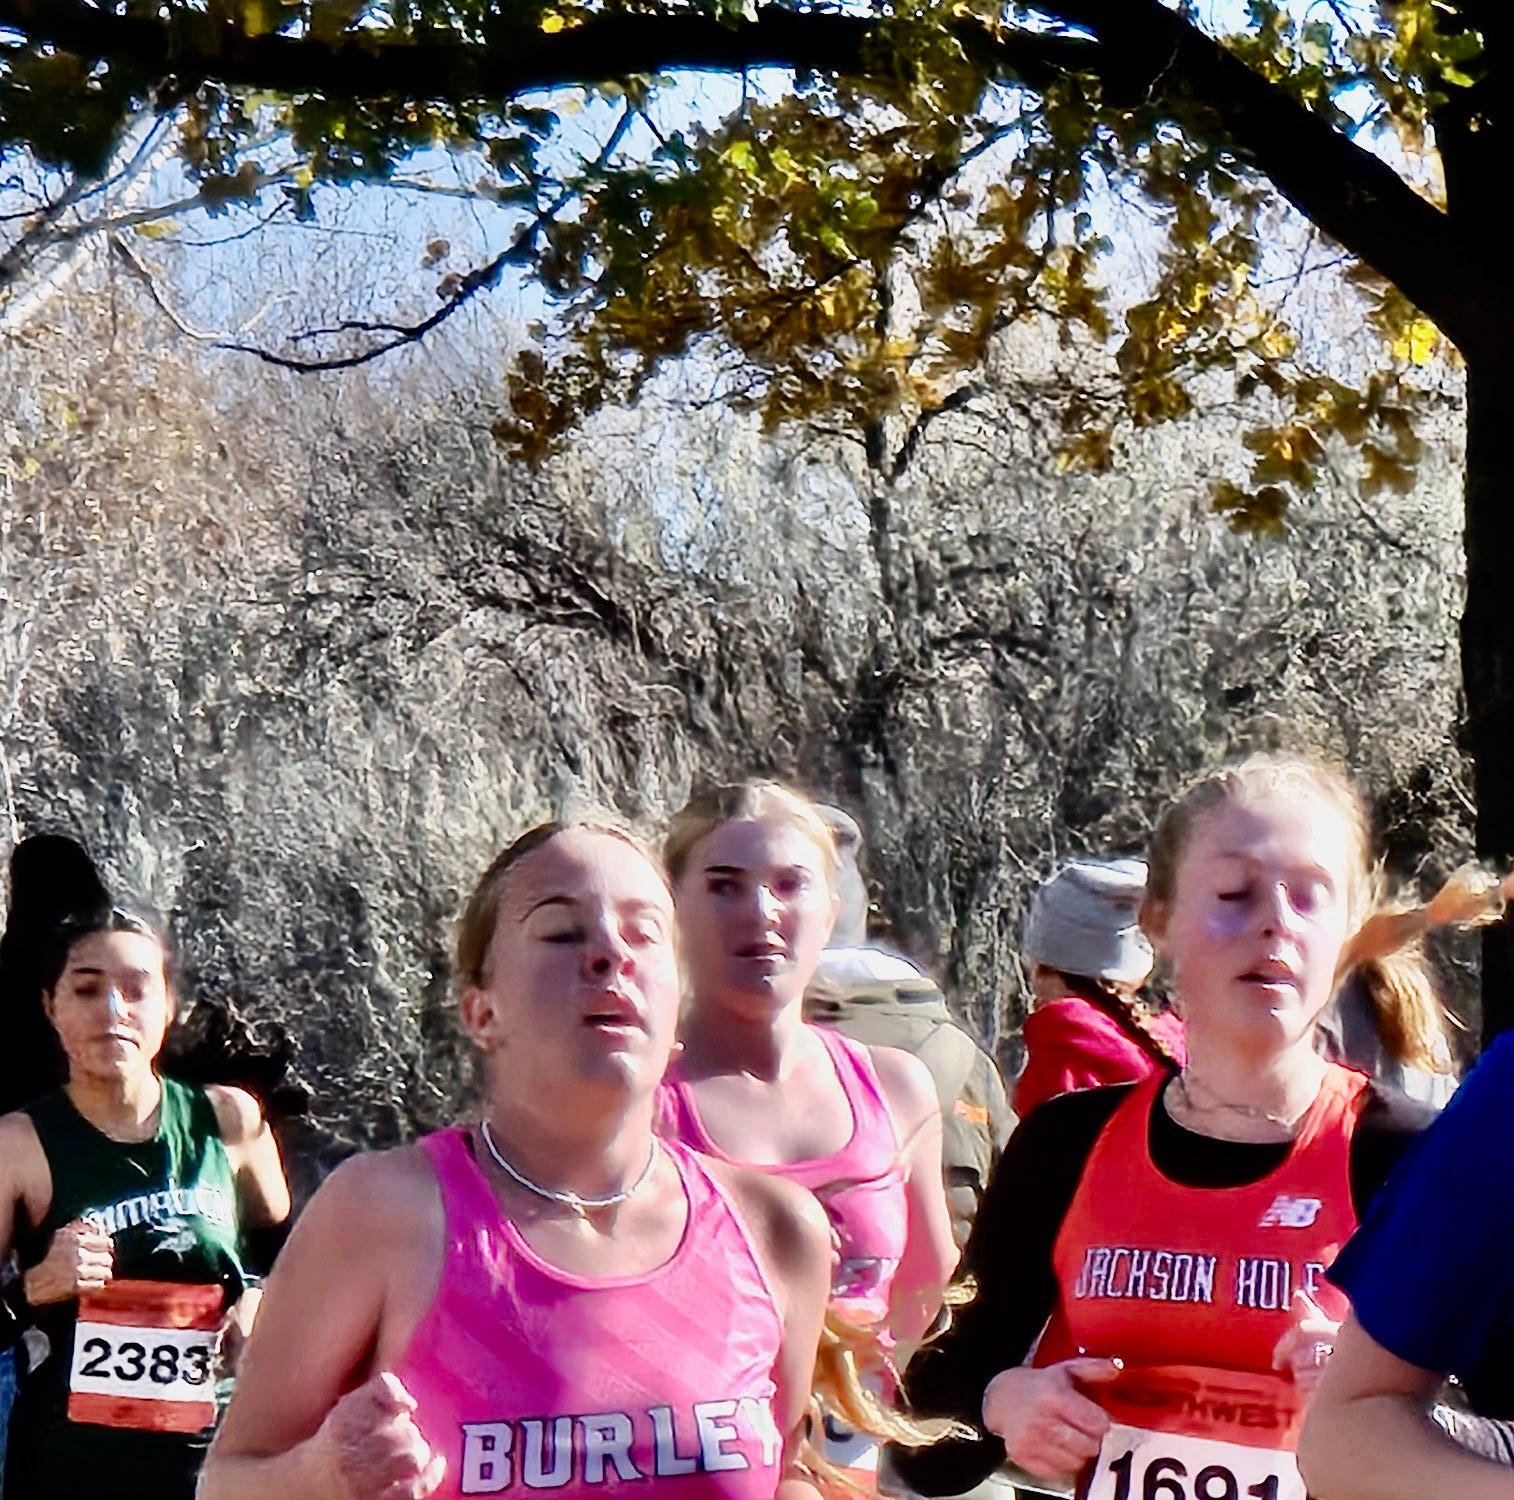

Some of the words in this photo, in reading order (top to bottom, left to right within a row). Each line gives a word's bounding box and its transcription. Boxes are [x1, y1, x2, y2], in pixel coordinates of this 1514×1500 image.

[1074, 1247, 1217, 1304] JACKSON
[80, 1337, 210, 1386] 2383
[462, 1396, 777, 1494] BURLEY
